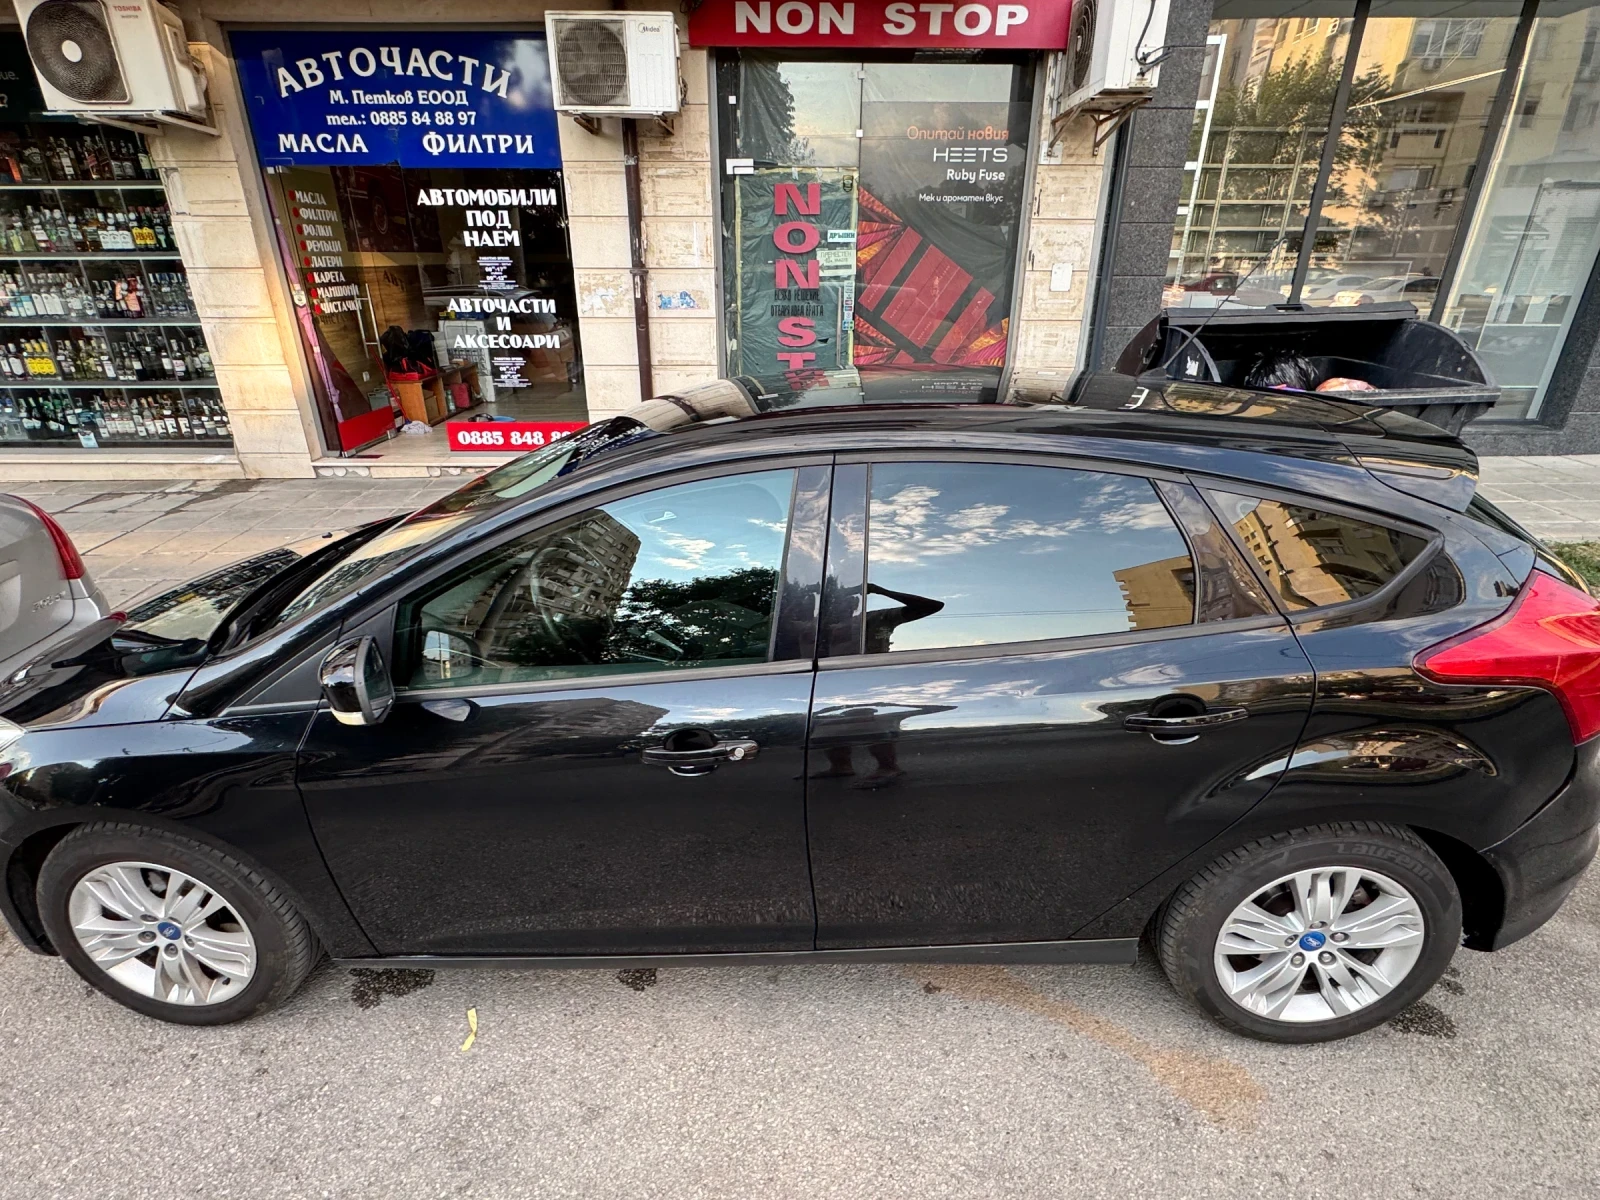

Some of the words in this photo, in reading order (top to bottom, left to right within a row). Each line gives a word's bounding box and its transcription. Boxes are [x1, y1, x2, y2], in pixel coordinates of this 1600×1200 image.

[734, 1, 855, 35] NON
[882, 2, 1030, 37] STOP
[277, 46, 511, 99] АВТОЧАСТИ
[329, 89, 349, 105] М.
[352, 89, 414, 105] Петков
[417, 90, 469, 106] ЕООД
[370, 111, 407, 126] 0885
[411, 111, 431, 126] 84
[434, 111, 454, 126] 88
[457, 111, 477, 126] 97
[906, 124, 964, 141] Опитай
[967, 124, 1009, 141] новия
[278, 132, 368, 154] МАСЛА
[422, 130, 534, 156] ФИЛТРИ
[933, 147, 1008, 163] HEETS
[946, 168, 976, 184] Ruby
[978, 168, 1006, 181] Fuse
[294, 190, 327, 206] МАСЛА
[416, 188, 557, 207] АВТОМОБИЛИ
[299, 208, 338, 223] ФИЛТРИ
[465, 209, 512, 230] ПОД
[302, 223, 333, 237] РОЛКИ
[772, 183, 822, 290] NON
[463, 230, 520, 247] НАЕМ
[311, 255, 344, 268] ЛАГЕРИ
[313, 271, 346, 284] КАРЕТА
[317, 283, 359, 299] МАНШОНИ
[320, 300, 362, 314] ЧИСТАЧКИ
[447, 298, 557, 314] АВТОЧАСТИ
[496, 316, 512, 331] И
[453, 334, 561, 349] АКСЕСОАРИ
[457, 430, 504, 446] 0885
[510, 430, 544, 446] 848
